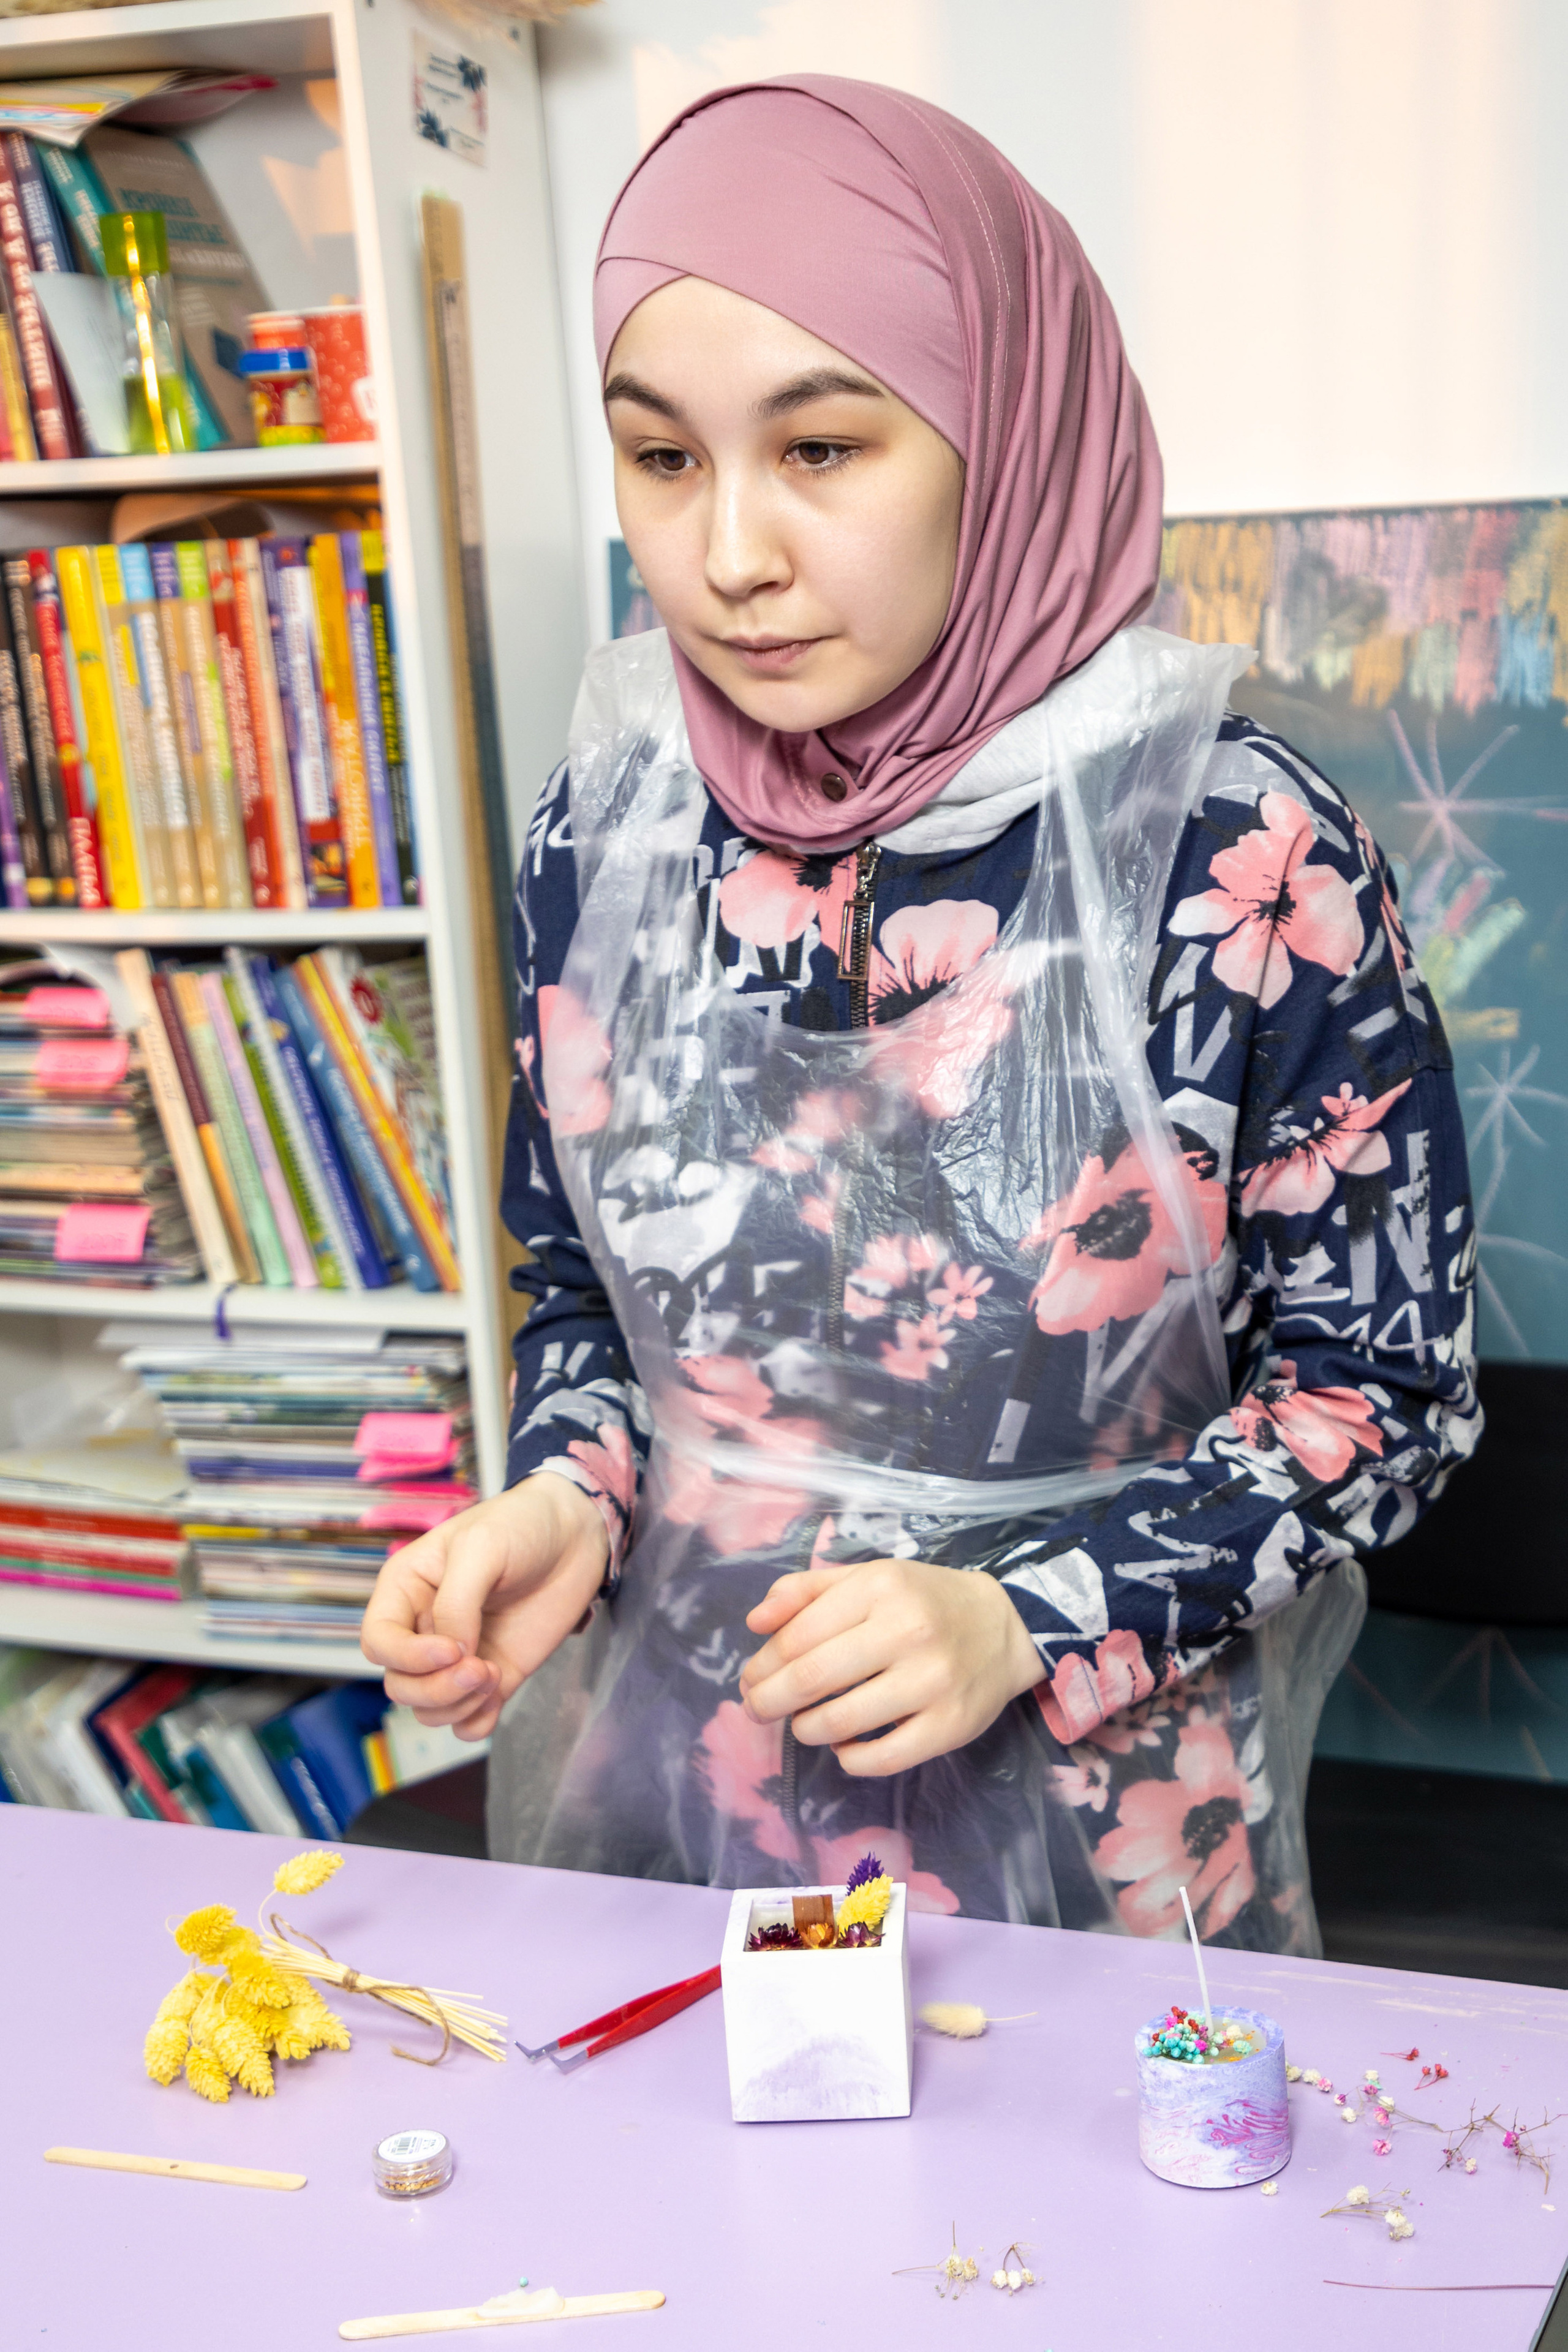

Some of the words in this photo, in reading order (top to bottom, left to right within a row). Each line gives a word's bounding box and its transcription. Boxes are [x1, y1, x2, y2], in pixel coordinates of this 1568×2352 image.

[0, 180, 16, 203] Я
[2, 237, 26, 260] А
[351, 621, 377, 725] ИДЕАЛЬНЫЙ
[364, 728, 386, 794] СИЛУЭТ
